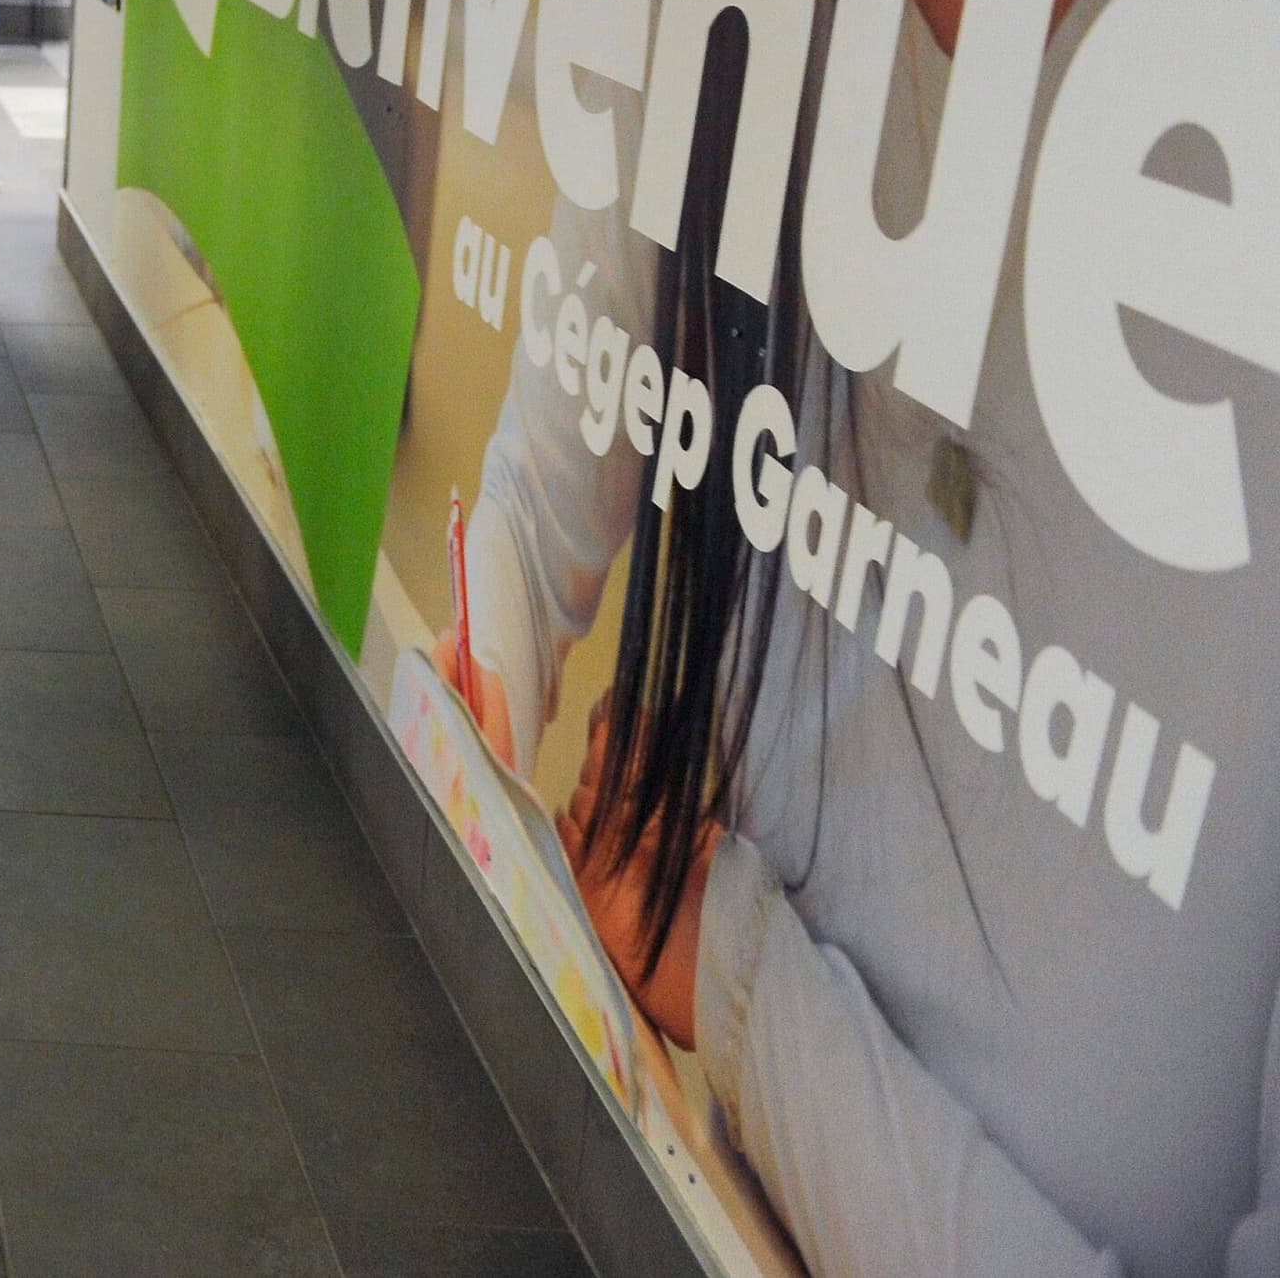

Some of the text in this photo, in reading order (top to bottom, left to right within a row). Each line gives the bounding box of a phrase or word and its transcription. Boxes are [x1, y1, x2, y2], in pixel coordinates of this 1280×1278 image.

[452, 214, 1218, 913] au Cégep Garneau
